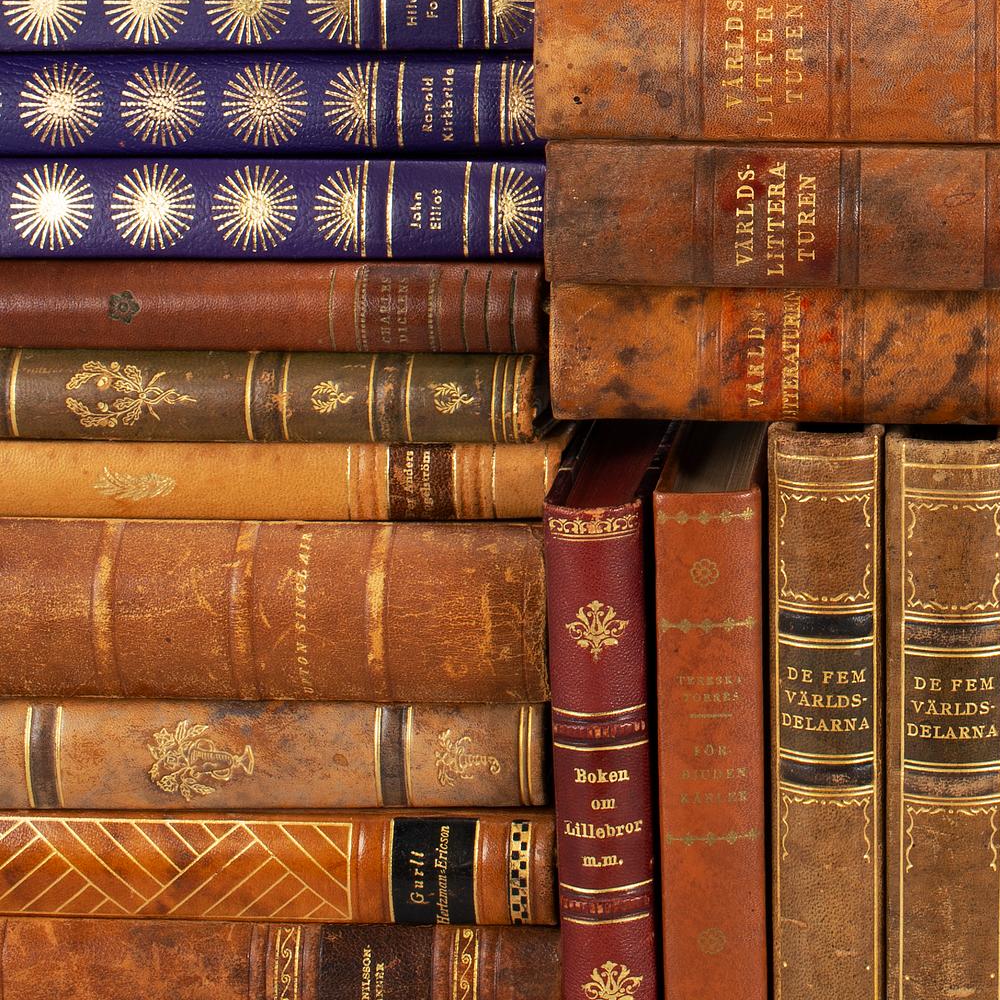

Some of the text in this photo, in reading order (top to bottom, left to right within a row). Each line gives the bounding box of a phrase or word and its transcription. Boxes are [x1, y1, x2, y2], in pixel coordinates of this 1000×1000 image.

[785, 2, 804, 105] TUREN
[421, 76, 434, 134] Ronald
[440, 67, 455, 142] Kirkbride
[409, 191, 422, 230] John
[429, 188, 443, 231] Elliot
[734, 163, 756, 267] VÄRLDS-
[766, 160, 787, 277] LITTERA-
[797, 173, 817, 262] TUREN
[379, 275, 392, 344] CHARLES
[397, 276, 409, 343] DICKENS
[403, 450, 414, 494] Anders
[294, 532, 315, 694] UPTON SINCLAIR
[787, 666, 866, 684] DE FEM
[913, 676, 994, 692] DE FEM
[784, 689, 867, 708] VÄRLDS-
[910, 699, 995, 716] VÄRLDS-
[781, 712, 870, 732] DELARNA
[906, 722, 998, 740] DELARNA
[573, 767, 631, 784] Boken
[590, 798, 617, 810] om
[563, 819, 644, 839] Lillebror
[409, 849, 425, 905] Gurli
[581, 854, 624, 868] m.m.
